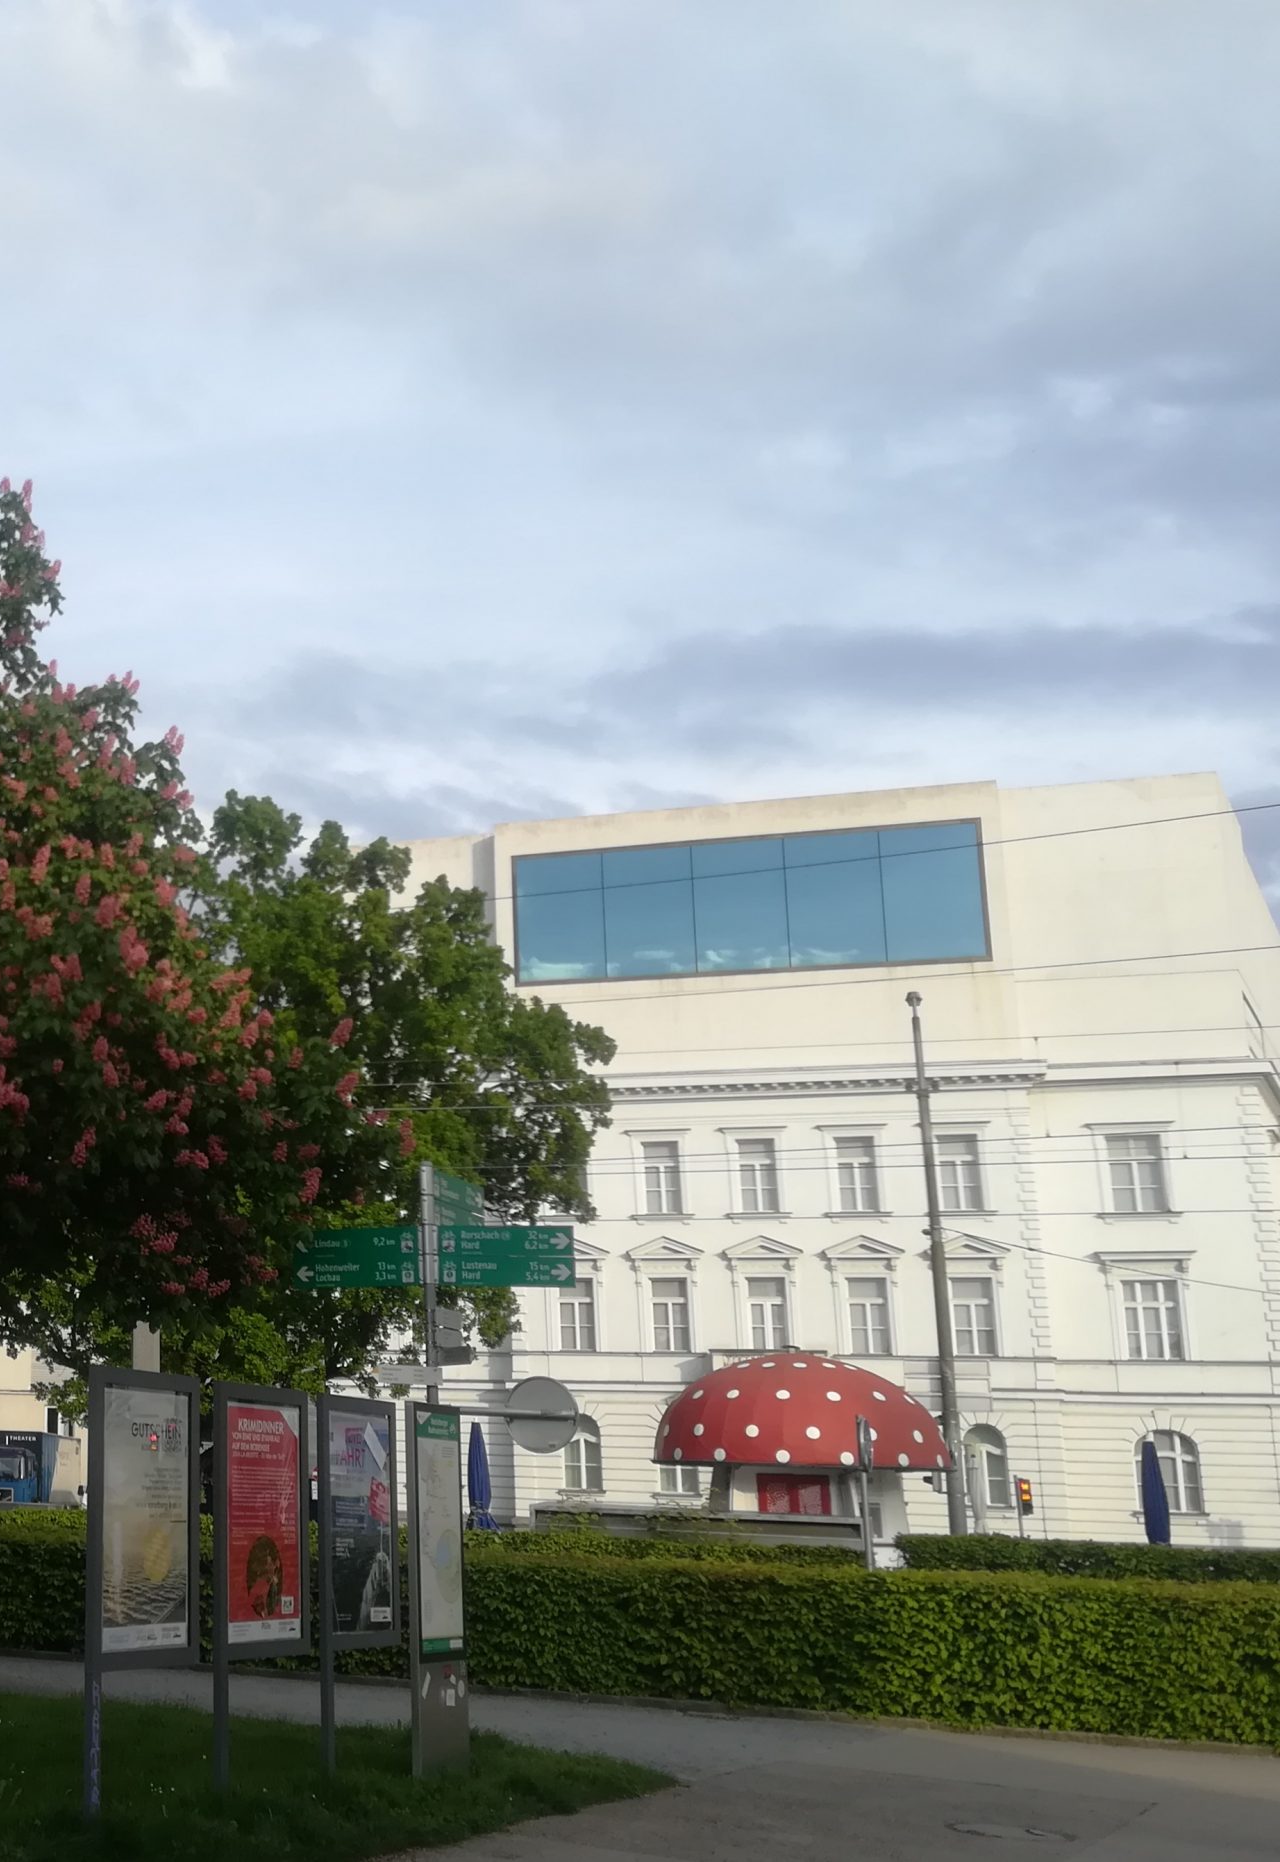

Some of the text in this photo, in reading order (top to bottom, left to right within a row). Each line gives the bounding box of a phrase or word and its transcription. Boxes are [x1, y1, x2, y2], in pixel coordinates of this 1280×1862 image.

[461, 1230, 500, 1240] Rorschach
[528, 1230, 538, 1240] 32
[315, 1239, 340, 1248] Lindau
[373, 1237, 385, 1247] 9,2
[386, 1238, 396, 1246] km
[461, 1240, 480, 1250] Hard
[525, 1241, 538, 1250] 6,2
[315, 1262, 360, 1272] Hohenweiler
[377, 1262, 386, 1270] 13
[462, 1261, 498, 1270] Lustenau
[529, 1261, 539, 1270] 15
[315, 1273, 341, 1282] Lochau
[375, 1272, 386, 1281] 3,3
[462, 1271, 481, 1280] Hard
[131, 1421, 182, 1440] GUTSCHEIN
[238, 1418, 284, 1434] KRIMIDINNER
